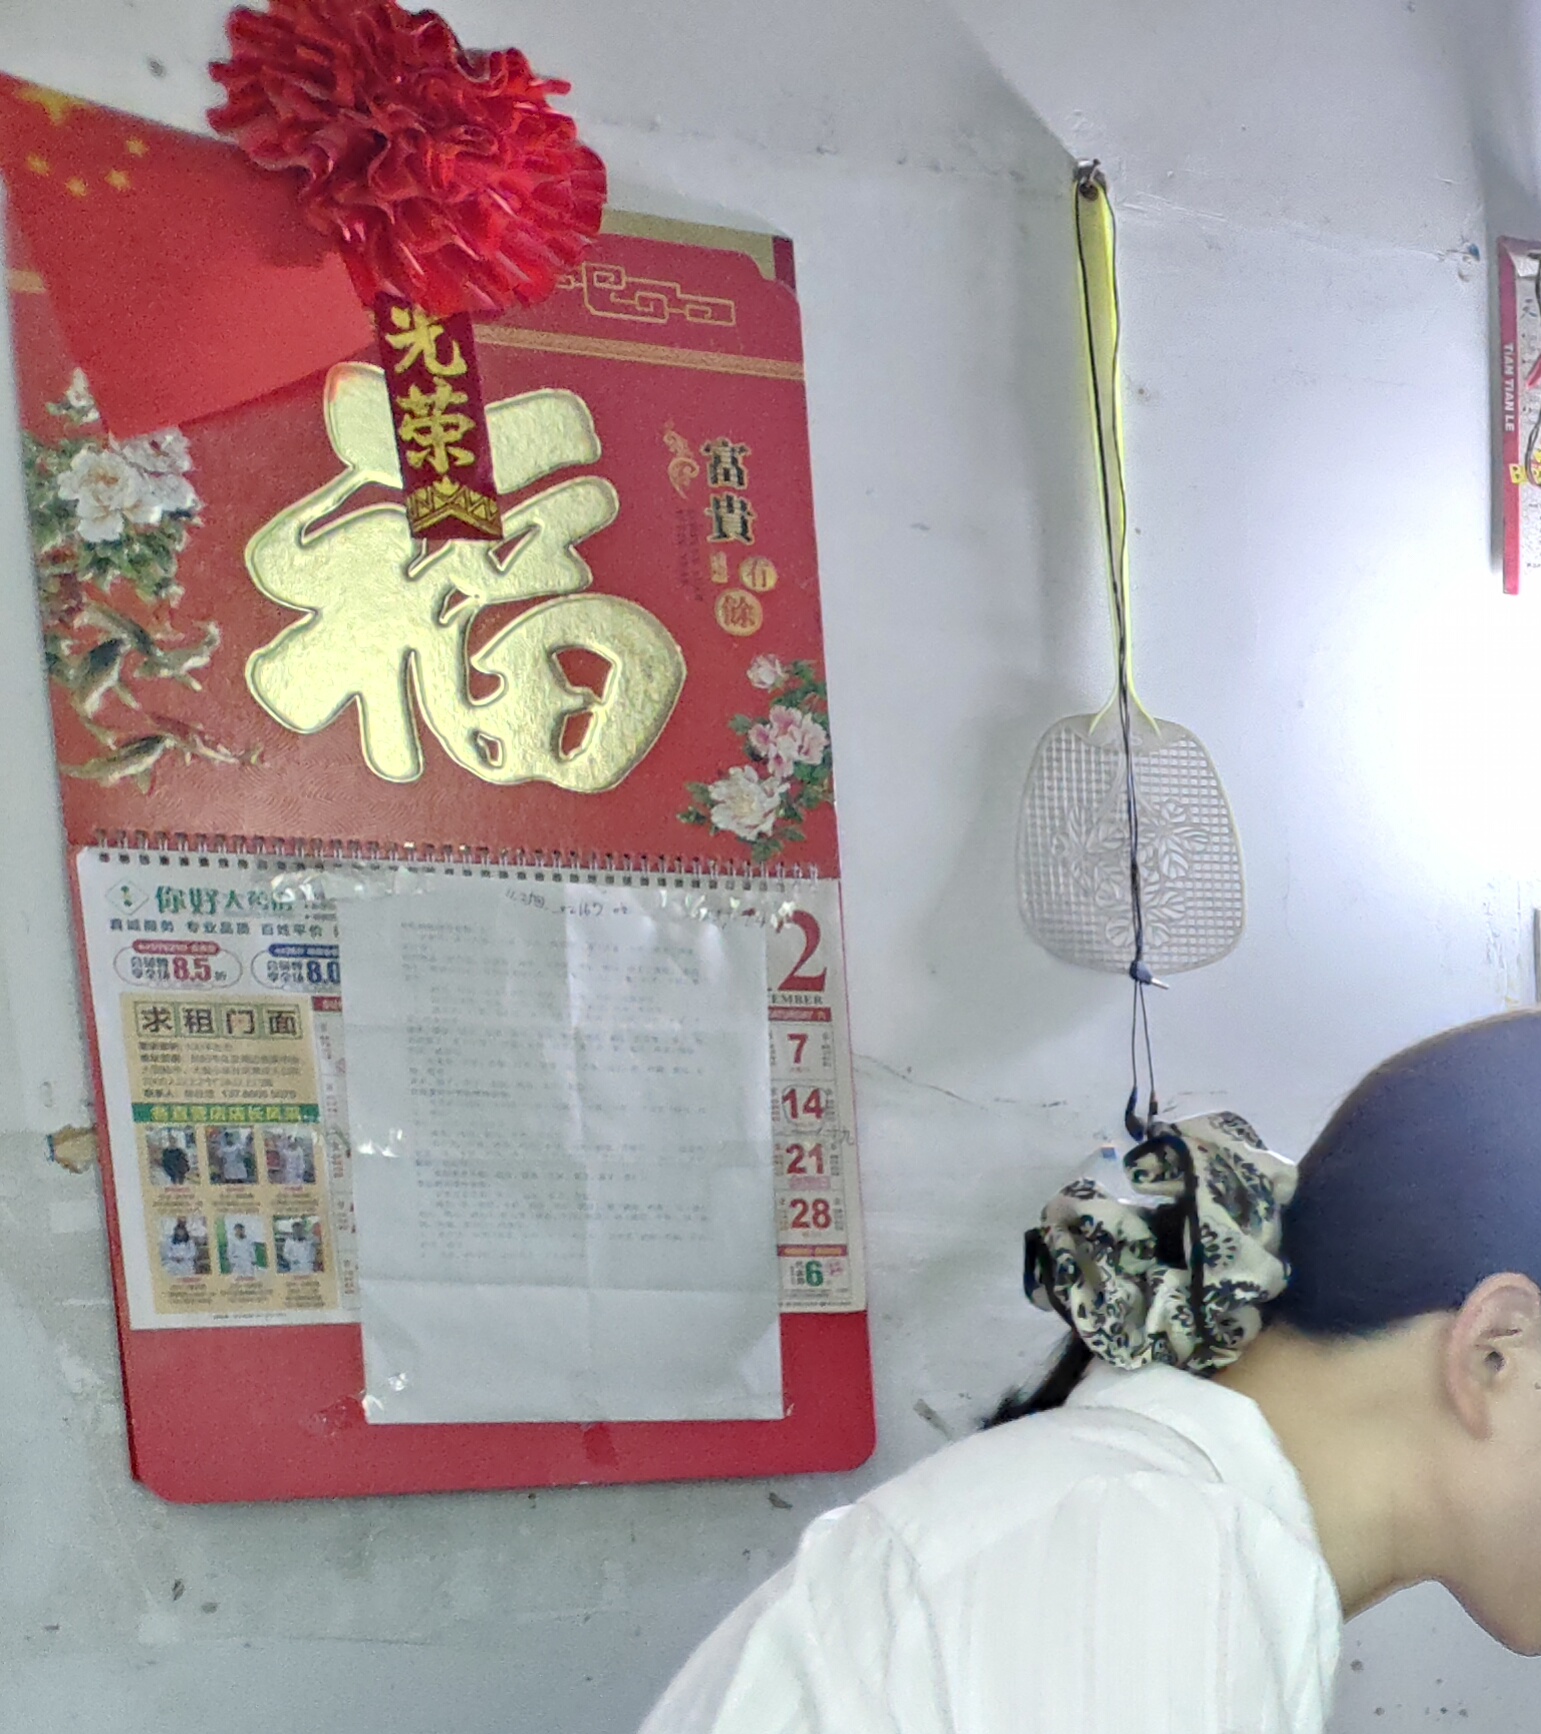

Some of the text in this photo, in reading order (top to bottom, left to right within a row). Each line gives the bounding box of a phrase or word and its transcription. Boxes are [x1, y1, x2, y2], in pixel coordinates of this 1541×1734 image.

[385, 304, 476, 474] 光荣
[1503, 342, 1515, 432] TIAN TIAN LE
[246, 361, 687, 793] 福
[776, 909, 828, 992] 2
[172, 956, 212, 981] 8.5
[306, 960, 340, 984] 8.0
[140, 1006, 297, 1035] 求租门面
[787, 1033, 809, 1064] 7
[782, 1088, 824, 1119] 14
[786, 1143, 825, 1175] 21
[789, 1198, 832, 1231] 28
[805, 1260, 824, 1287] 6
